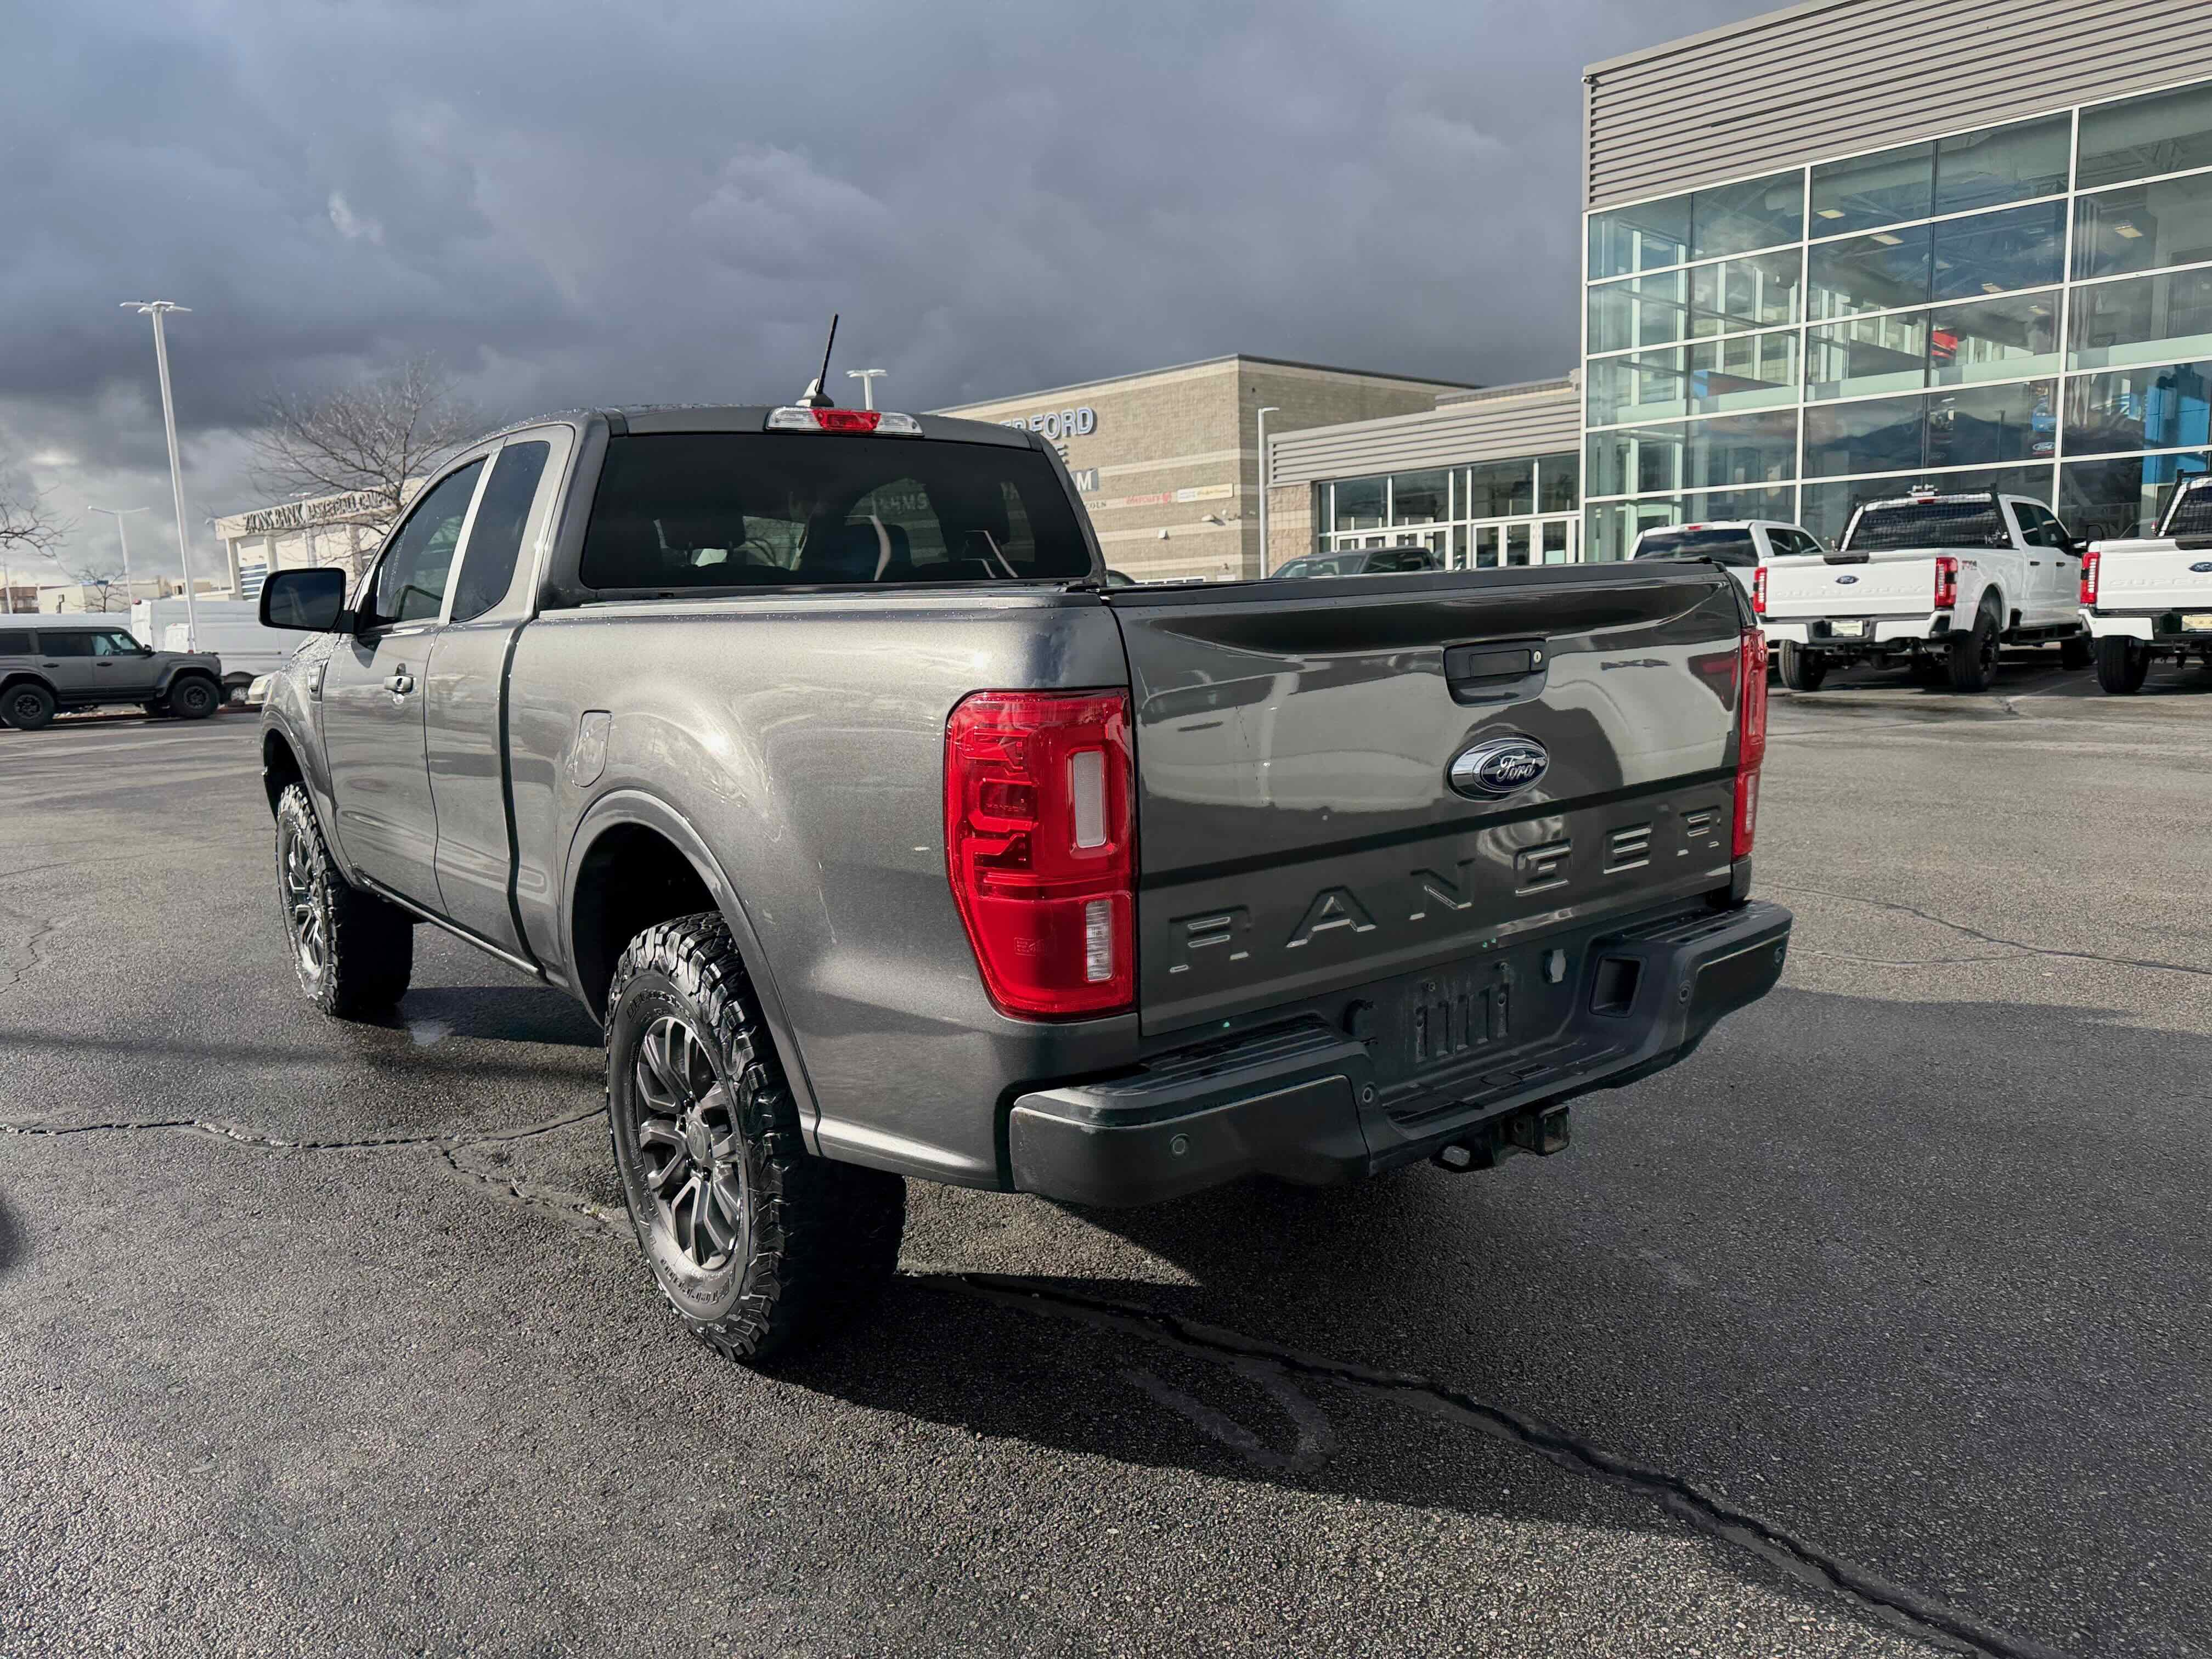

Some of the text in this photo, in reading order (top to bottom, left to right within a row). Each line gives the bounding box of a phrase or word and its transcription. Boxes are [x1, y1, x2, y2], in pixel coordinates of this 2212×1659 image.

[1029, 407, 1093, 439] FORD
[1496, 754, 1536, 782] Ford
[1169, 804, 1722, 973] RANGER
